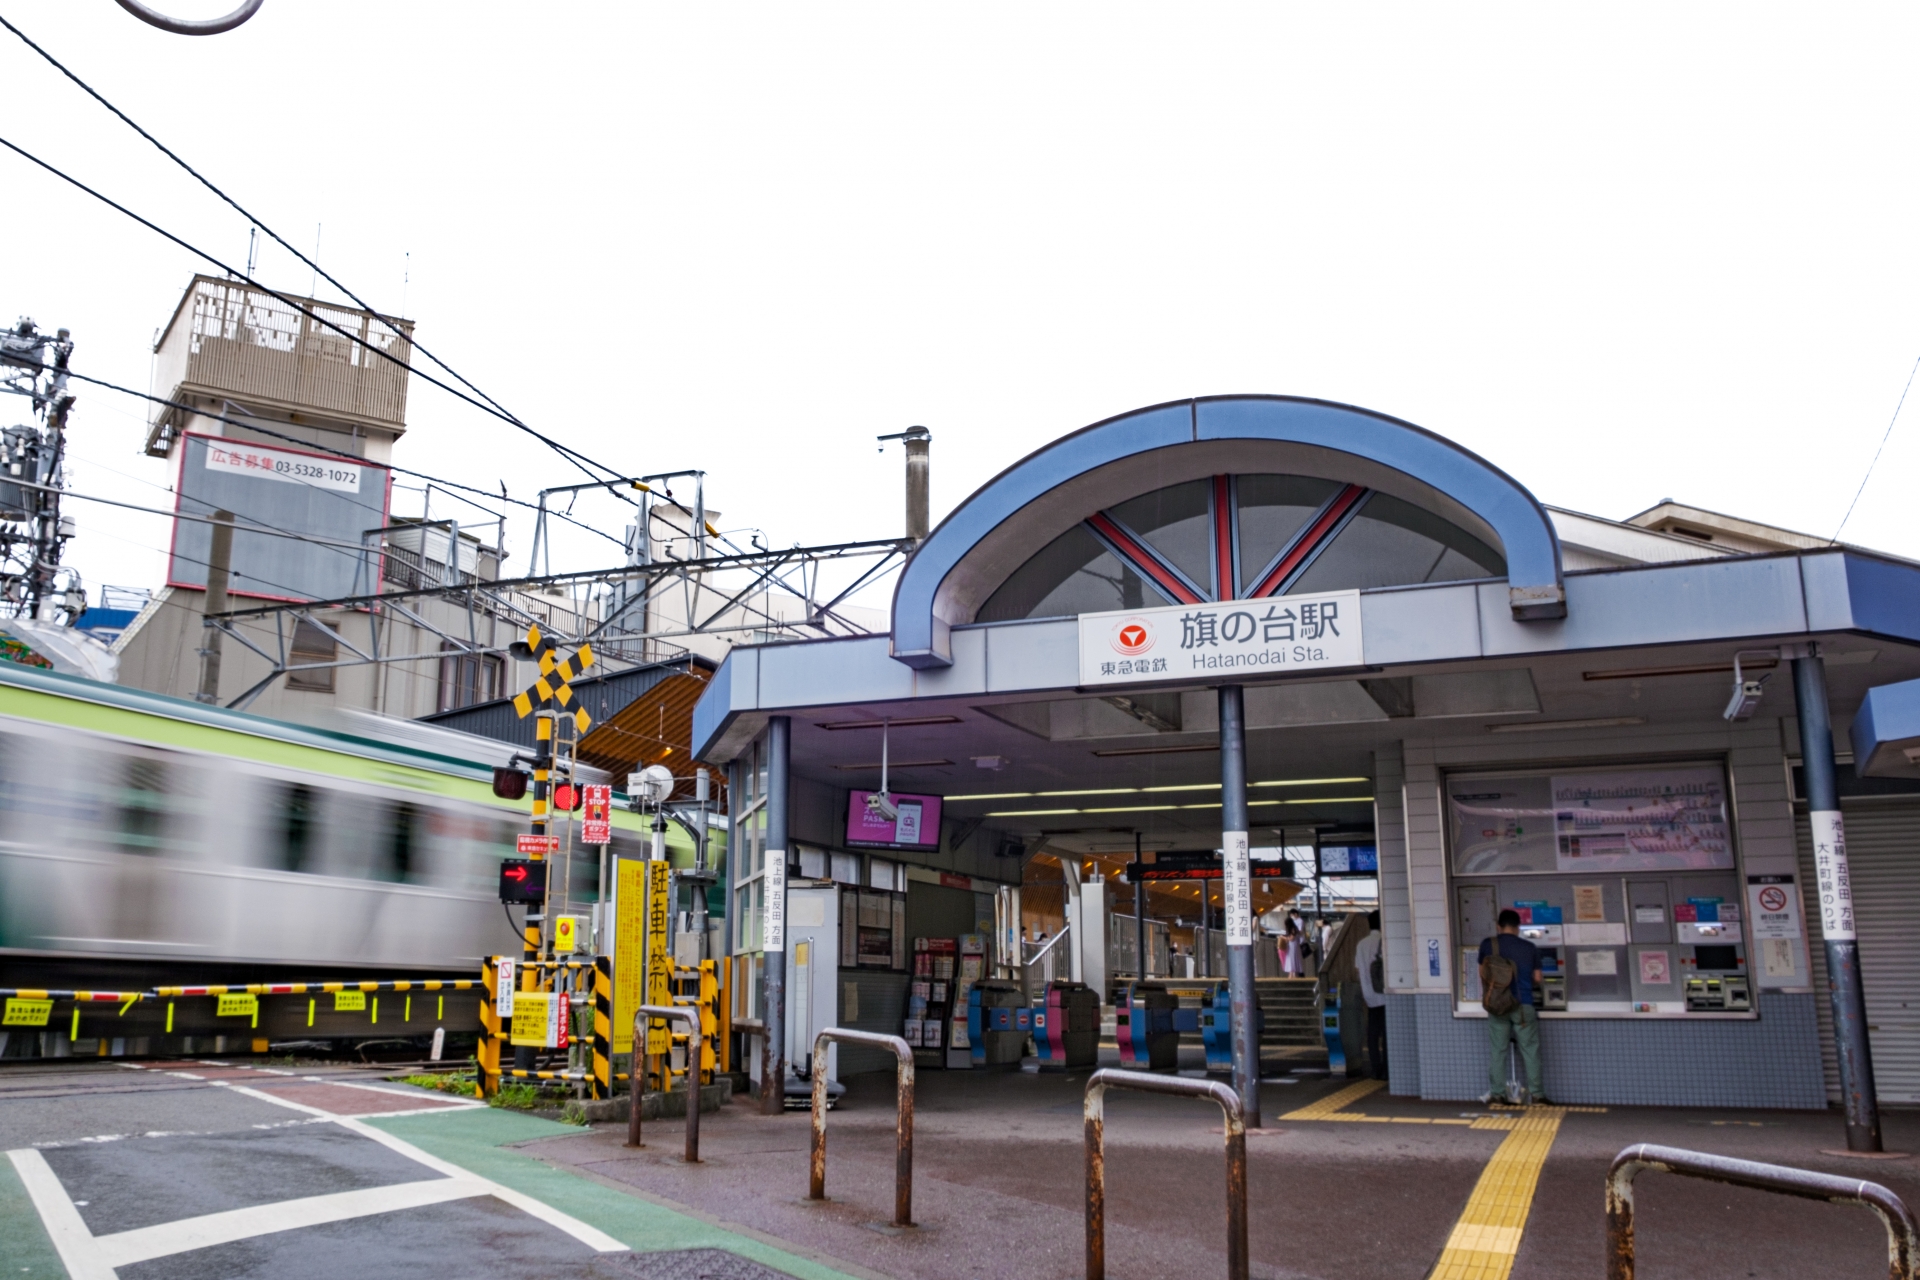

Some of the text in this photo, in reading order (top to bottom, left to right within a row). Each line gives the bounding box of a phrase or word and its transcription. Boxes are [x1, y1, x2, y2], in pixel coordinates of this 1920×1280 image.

[211, 449, 357, 484] 広告募集 03-5328-1072
[1125, 616, 1154, 629] CORPORATION
[1180, 601, 1340, 650] 旗の台駅
[1100, 658, 1168, 676] 東急電鉄
[1192, 645, 1330, 669] Hatanodai Sta.
[520, 836, 558, 844] 監視カメラ作中
[863, 815, 890, 824] PASM
[1357, 854, 1377, 863] BRA
[1832, 819, 1854, 931] 池上線 五反田 方面
[772, 857, 782, 944] 池上線 五反田 方面
[1225, 860, 1235, 937] 大井町線のりば
[1236, 839, 1249, 937] 池上線 五反田 方面
[1817, 843, 1837, 931] 大井町線のりば
[649, 864, 668, 1031] 駐車禁止
[559, 996, 567, 1045] 非常ボタン
